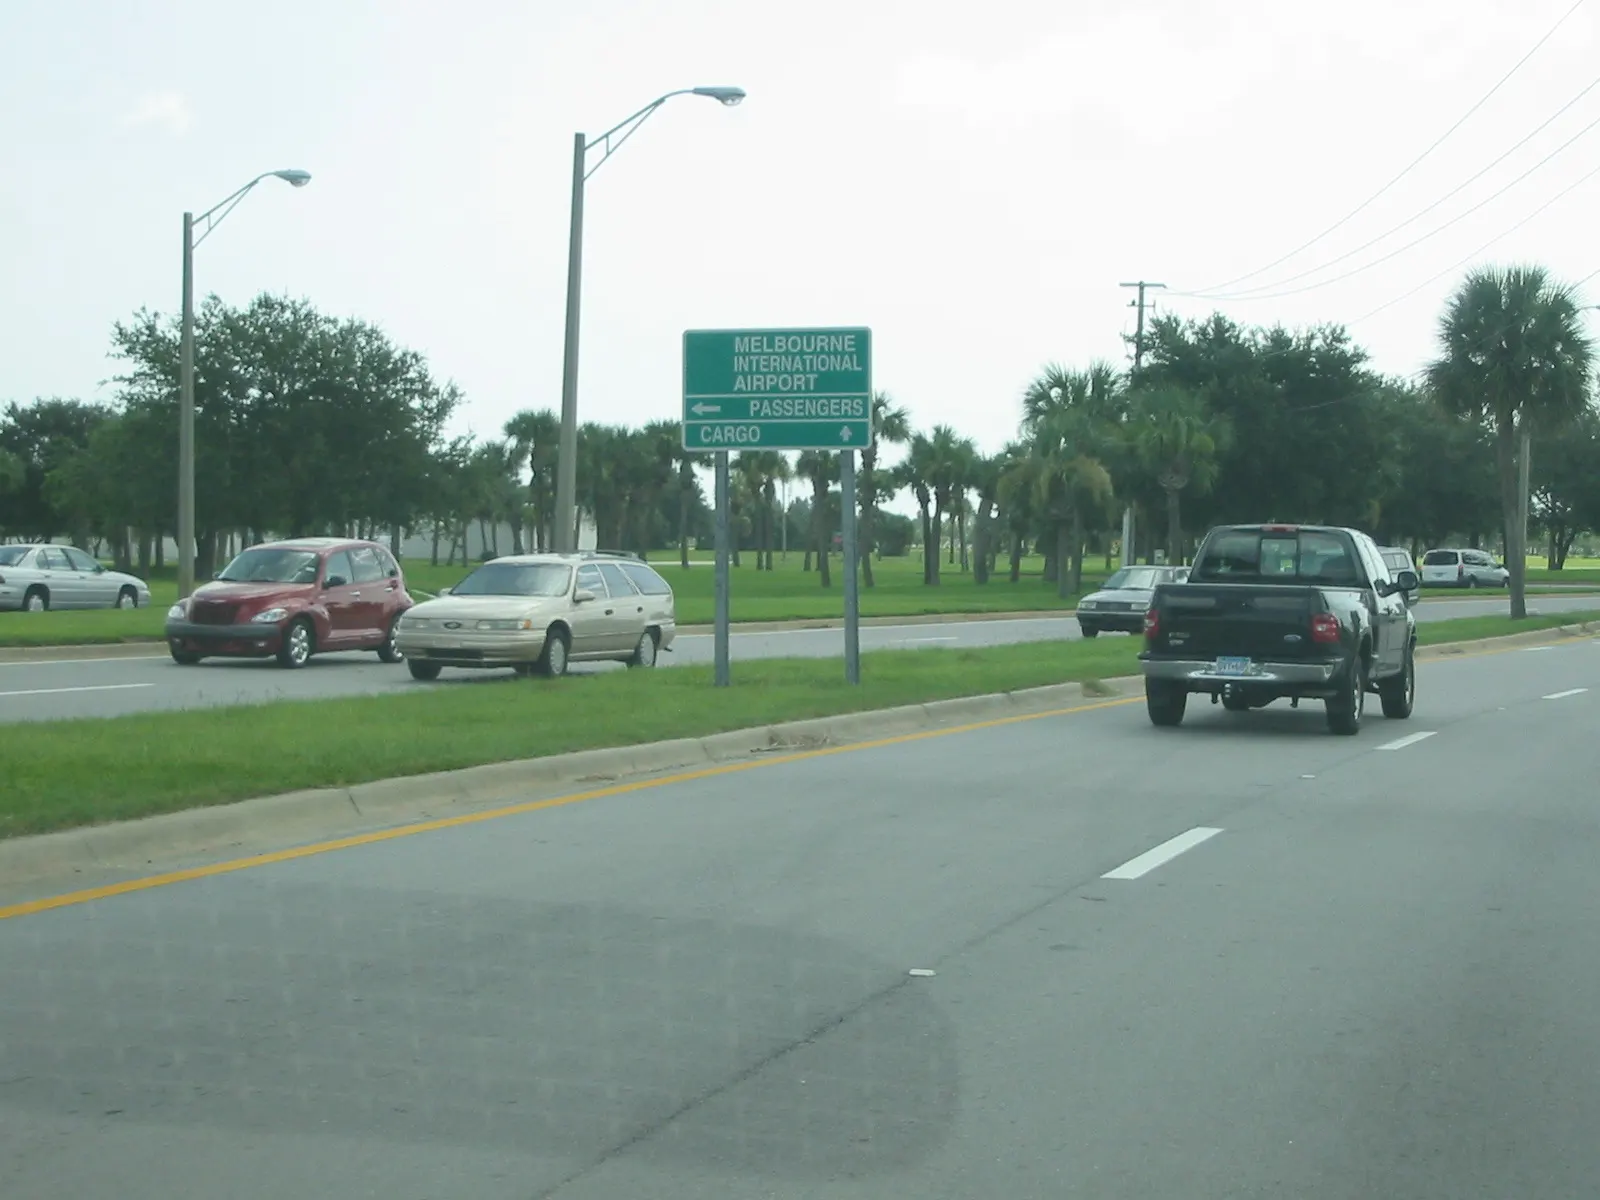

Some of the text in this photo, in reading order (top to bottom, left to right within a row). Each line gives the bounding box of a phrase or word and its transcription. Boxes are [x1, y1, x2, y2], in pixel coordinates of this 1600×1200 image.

[734, 335, 856, 353] MELBOURNE
[734, 354, 862, 372] INTERNATIONAL
[733, 374, 818, 391] AIRPORT
[750, 399, 863, 416] PASSENGERS
[700, 426, 760, 442] CARGO
